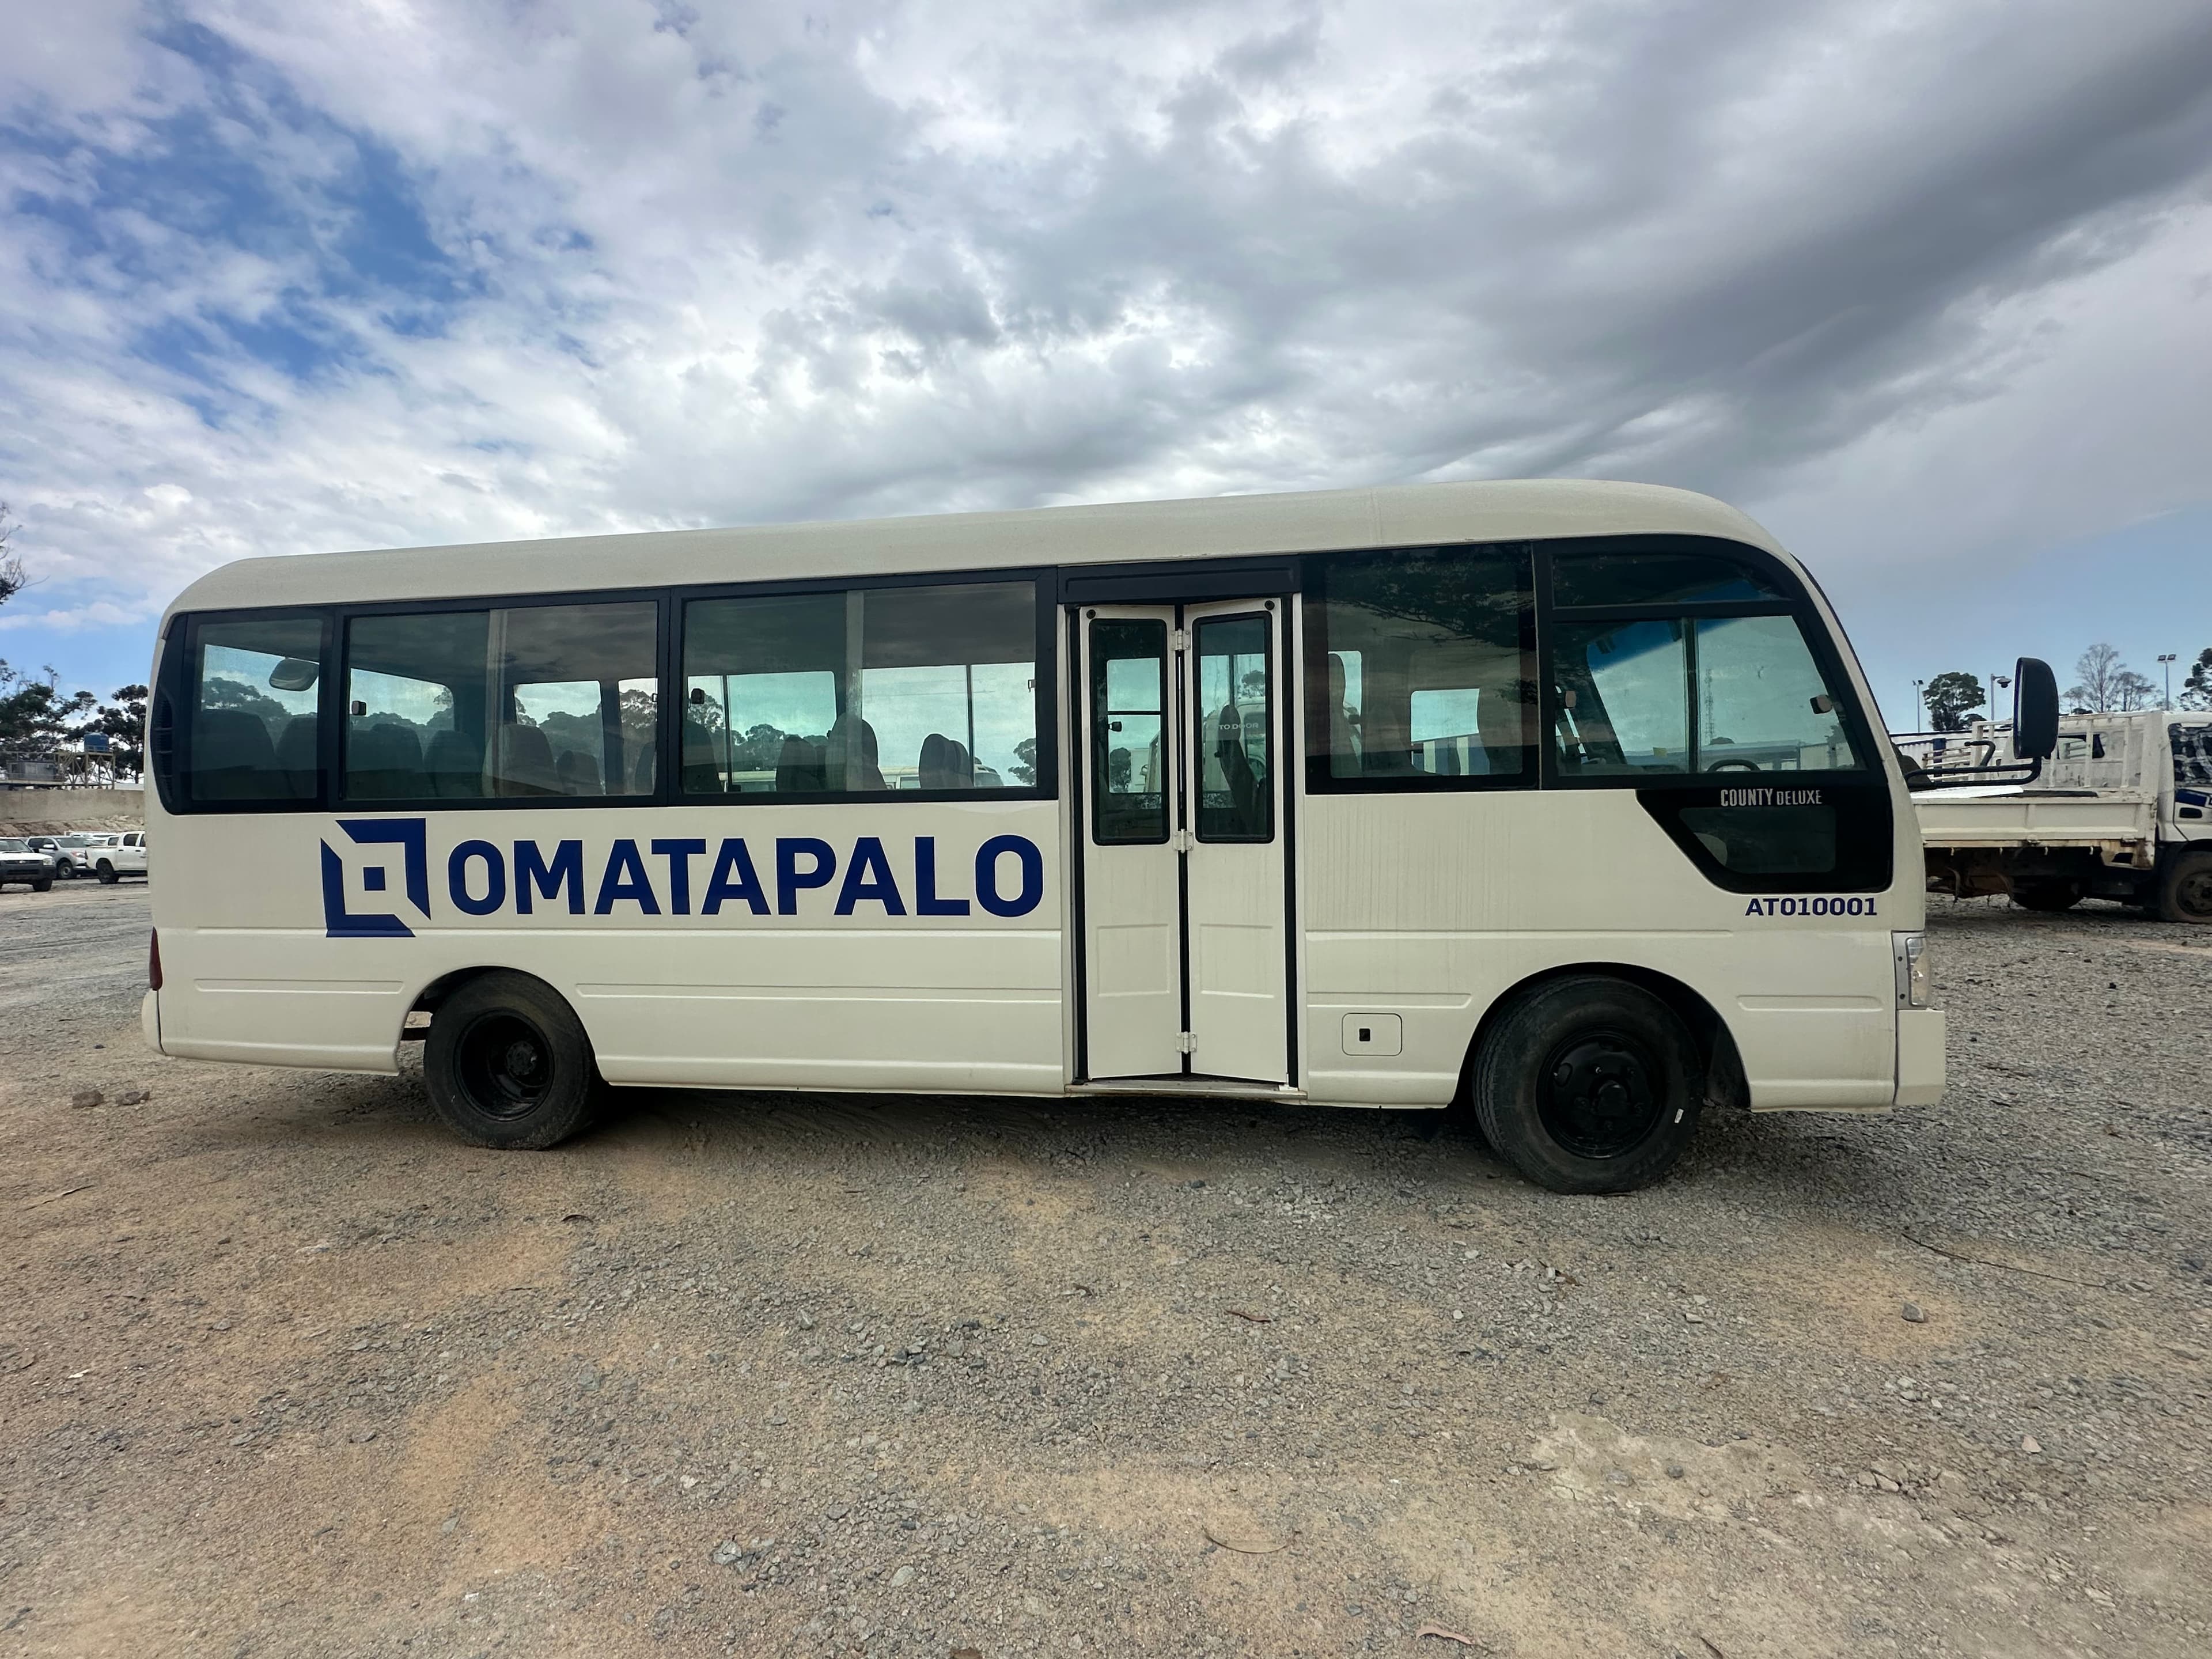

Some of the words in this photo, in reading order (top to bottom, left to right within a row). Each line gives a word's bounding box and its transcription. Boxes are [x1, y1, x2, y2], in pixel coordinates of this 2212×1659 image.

[1720, 788, 1773, 806] COUNTY
[1776, 790, 1823, 805] DELUXE
[448, 835, 1043, 917] OMATAPALO
[1744, 897, 1877, 916] AT010001
